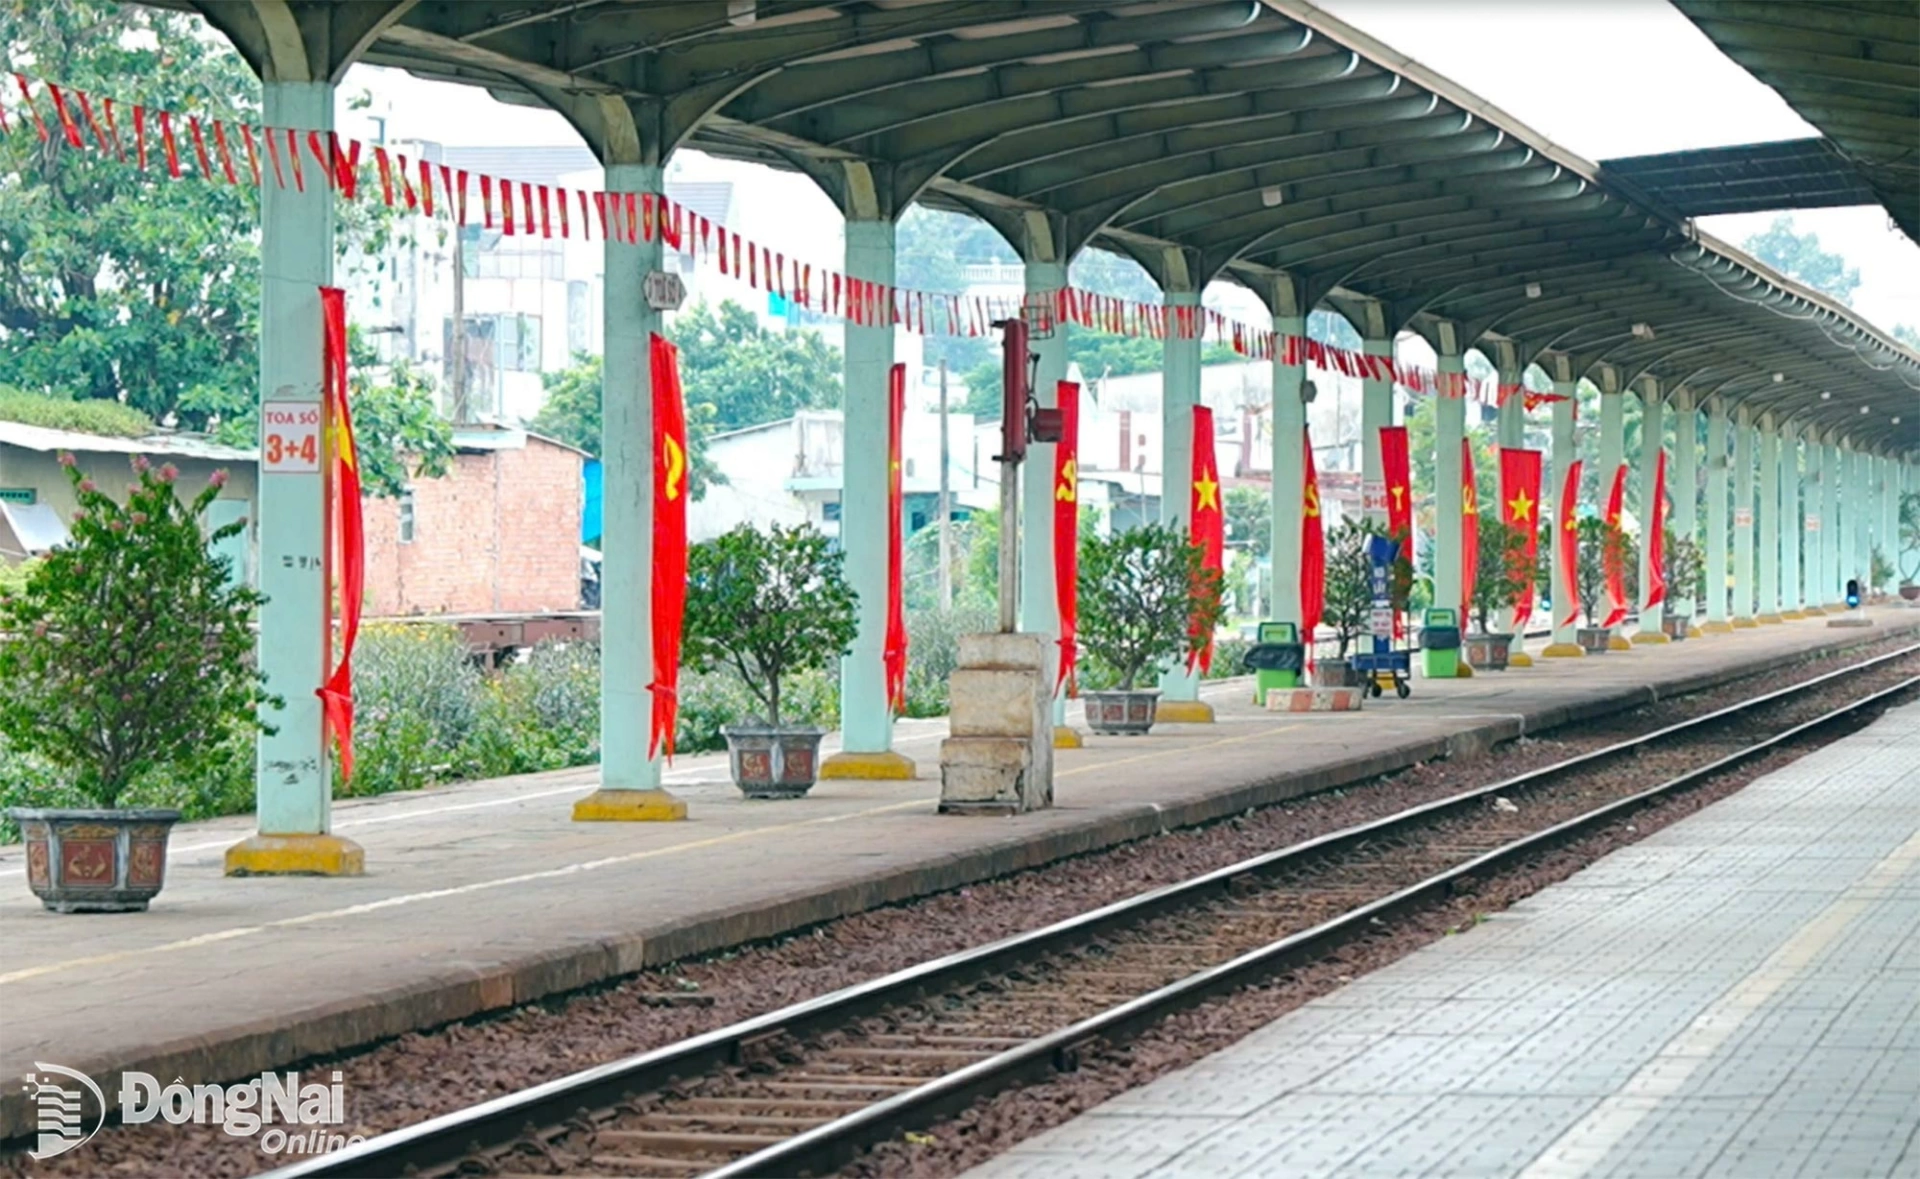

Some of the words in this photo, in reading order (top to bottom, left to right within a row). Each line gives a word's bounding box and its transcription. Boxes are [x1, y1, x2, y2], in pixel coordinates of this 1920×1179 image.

[266, 412, 295, 424] TOA
[299, 408, 319, 424] SỐ
[267, 434, 316, 464] 3+4
